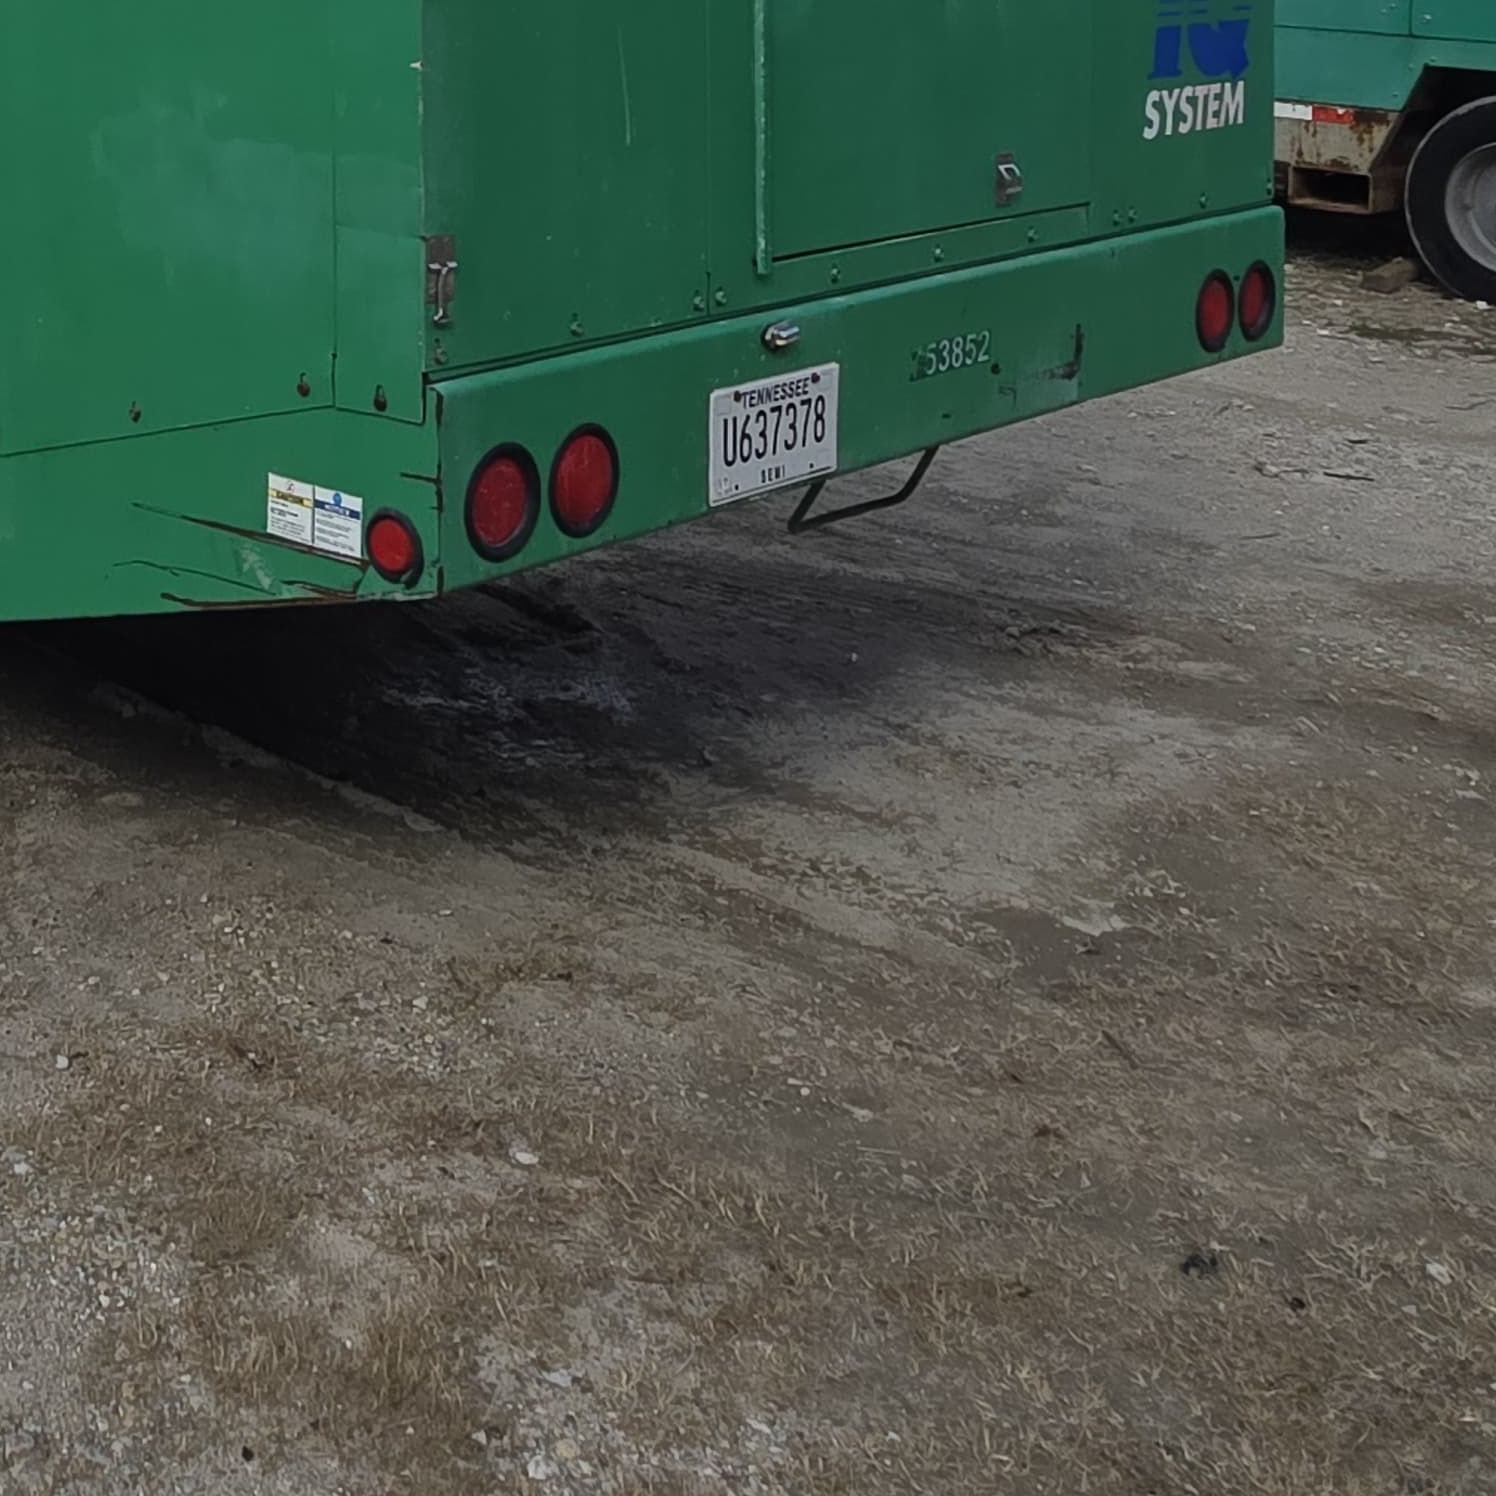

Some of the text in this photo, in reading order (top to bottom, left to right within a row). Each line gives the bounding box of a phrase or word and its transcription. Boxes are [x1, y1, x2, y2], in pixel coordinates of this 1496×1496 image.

[1142, 81, 1245, 140] SYSTEM
[741, 377, 810, 408] TENNESSEE
[723, 395, 825, 467] U637378
